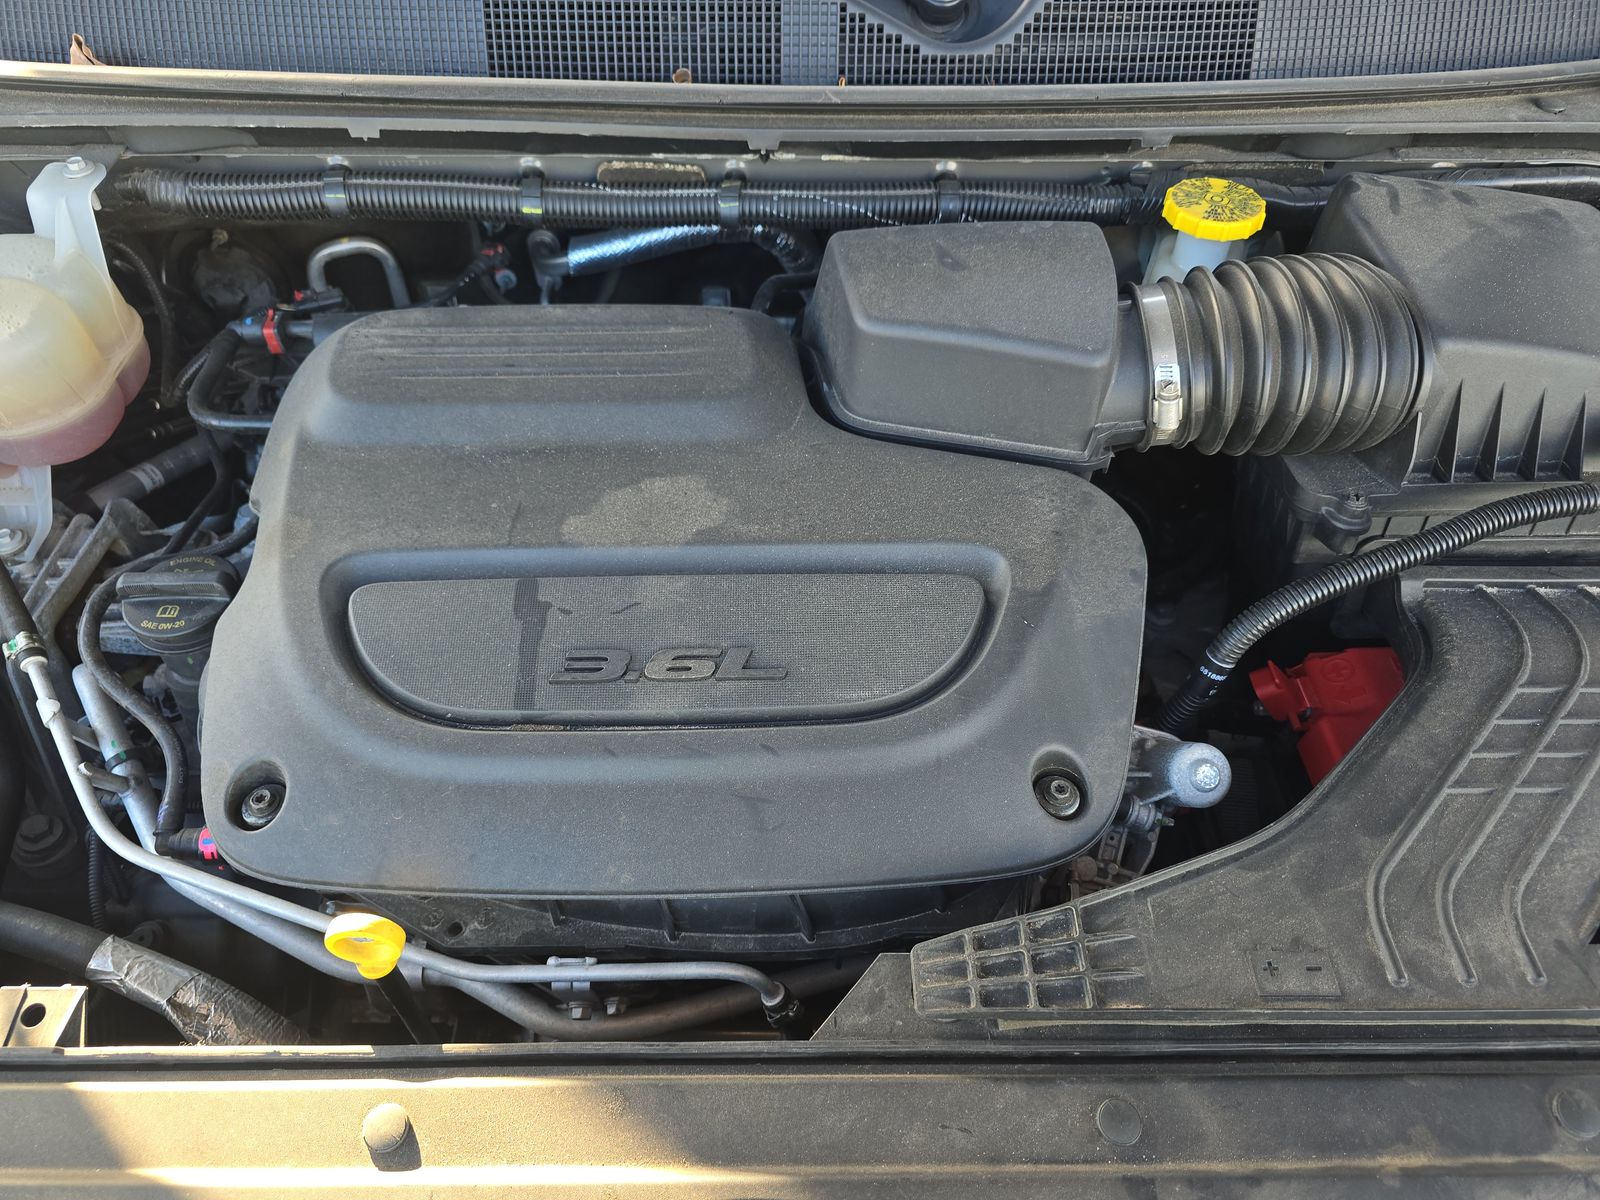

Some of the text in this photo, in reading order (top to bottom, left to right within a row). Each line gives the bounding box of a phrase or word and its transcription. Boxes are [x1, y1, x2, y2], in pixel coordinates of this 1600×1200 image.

[169, 556, 203, 566] ENGINE
[140, 620, 185, 630] SAE 0W-20
[549, 647, 788, 684] 3.6L
